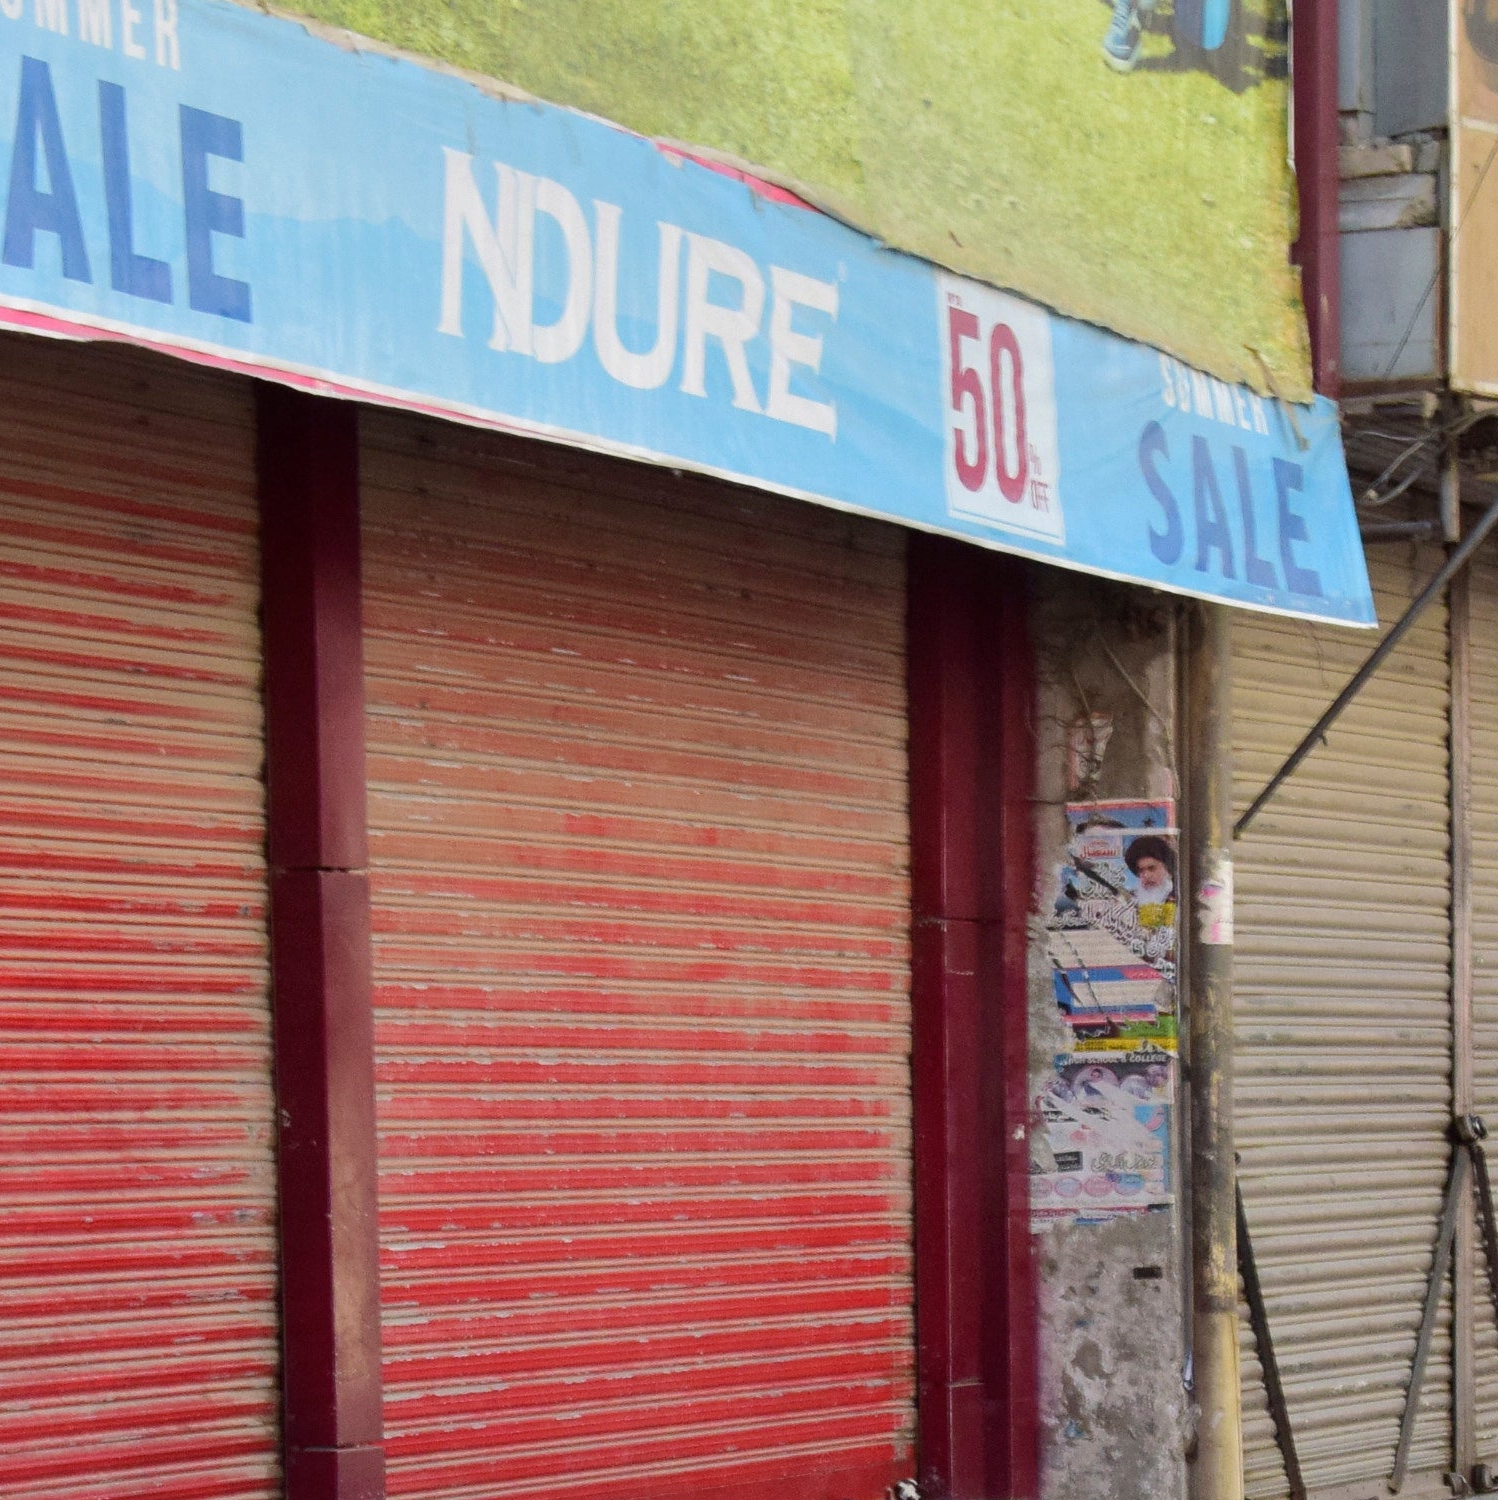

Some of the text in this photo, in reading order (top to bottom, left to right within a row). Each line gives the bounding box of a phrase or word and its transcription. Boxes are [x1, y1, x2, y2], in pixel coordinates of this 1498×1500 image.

[437, 146, 839, 444] NDURE
[948, 305, 1028, 504] 50
[1157, 352, 1270, 436] SUMMER
[1138, 420, 1324, 598] SALE
[1129, 1052, 1168, 1062] COLLEGE
